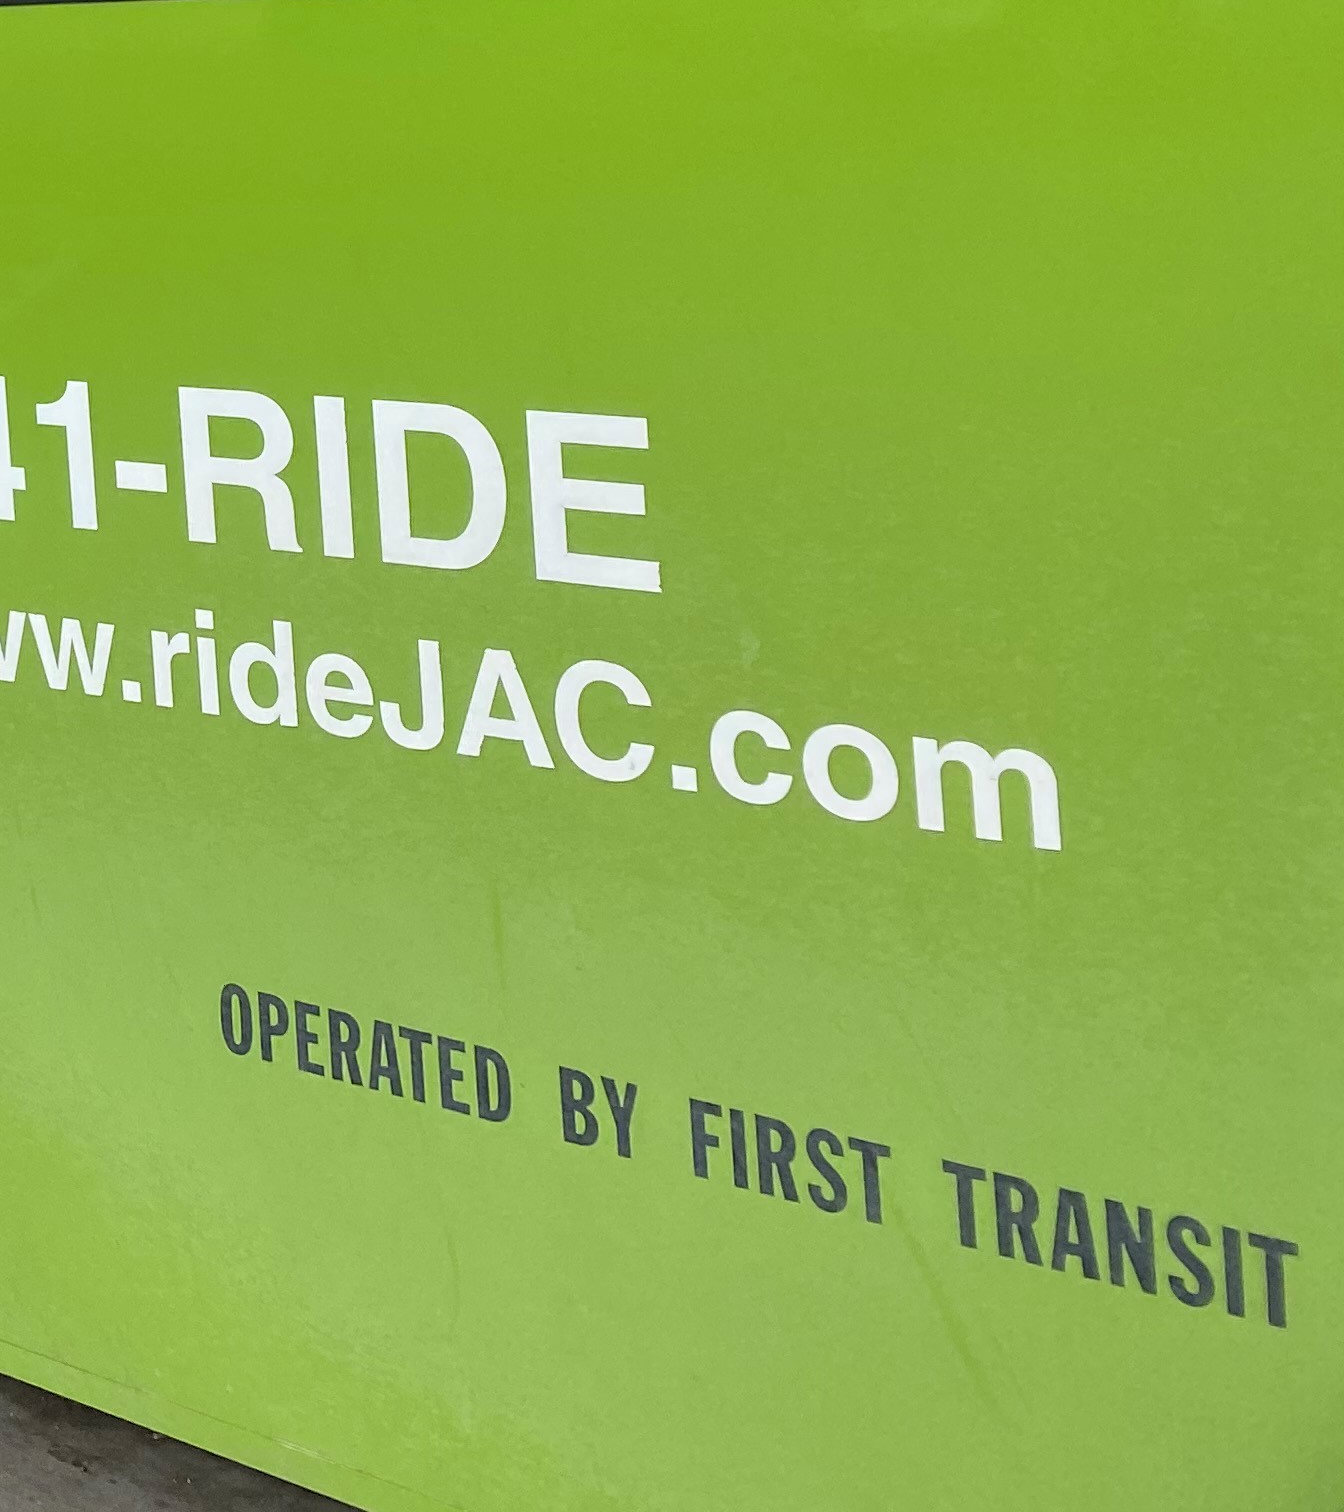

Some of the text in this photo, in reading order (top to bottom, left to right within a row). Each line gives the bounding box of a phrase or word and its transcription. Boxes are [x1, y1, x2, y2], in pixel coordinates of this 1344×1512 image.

[220, 983, 1298, 1328] OPERATED BY FIRST TRANSIT
